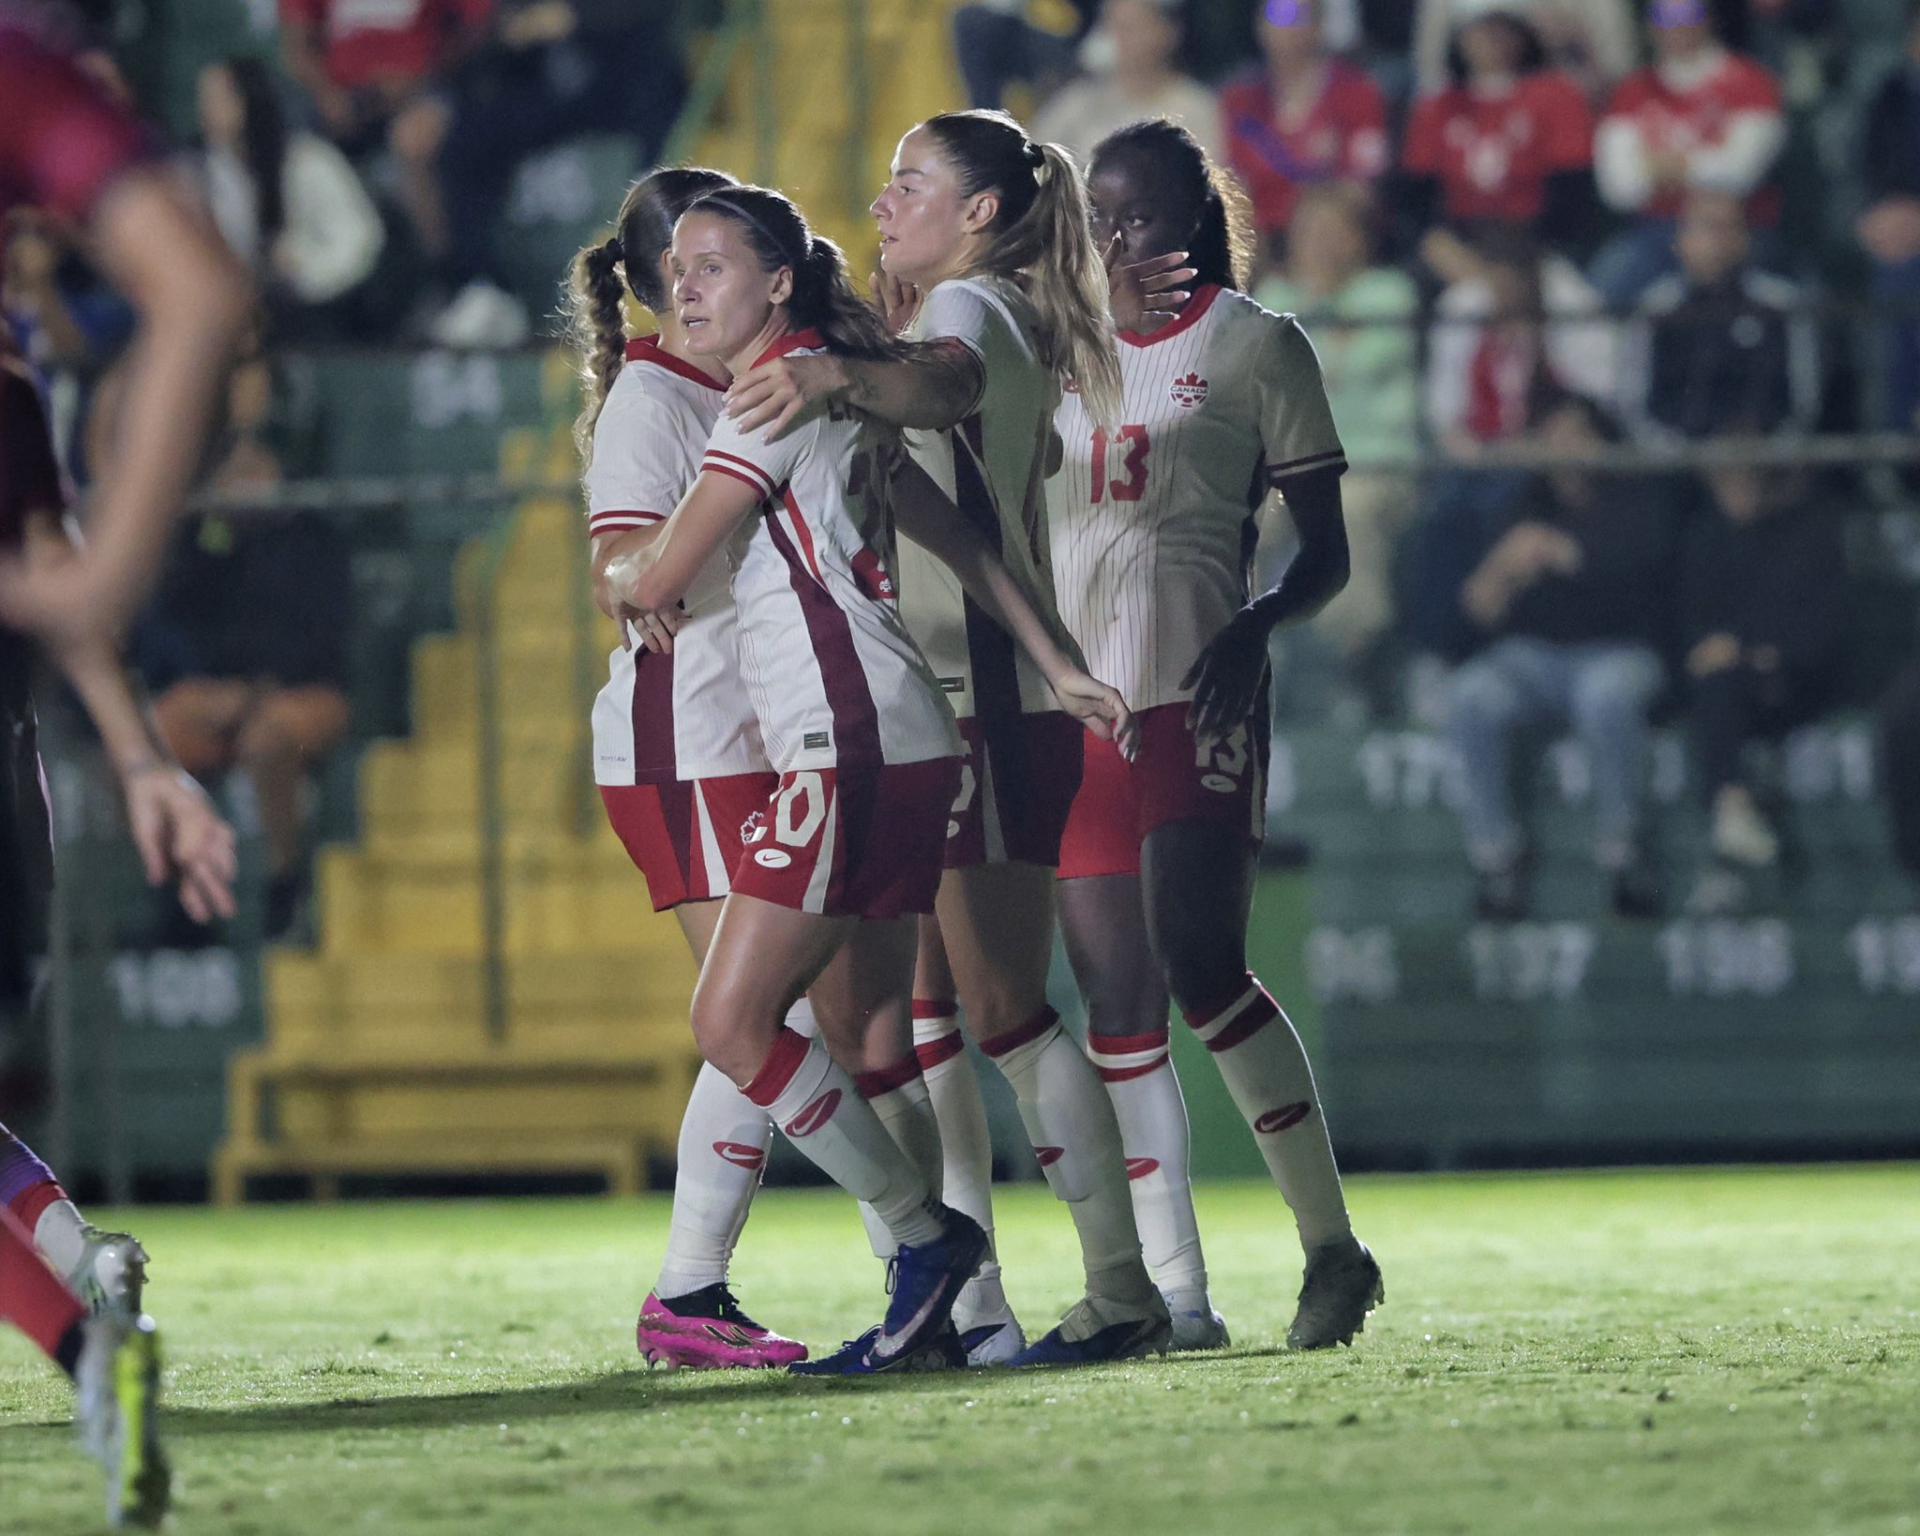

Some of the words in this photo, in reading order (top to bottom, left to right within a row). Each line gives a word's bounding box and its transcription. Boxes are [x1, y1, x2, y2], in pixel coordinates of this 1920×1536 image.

[1170, 385, 1208, 394] CANADA
[1090, 424, 1151, 504] 13
[754, 771, 826, 848] 0
